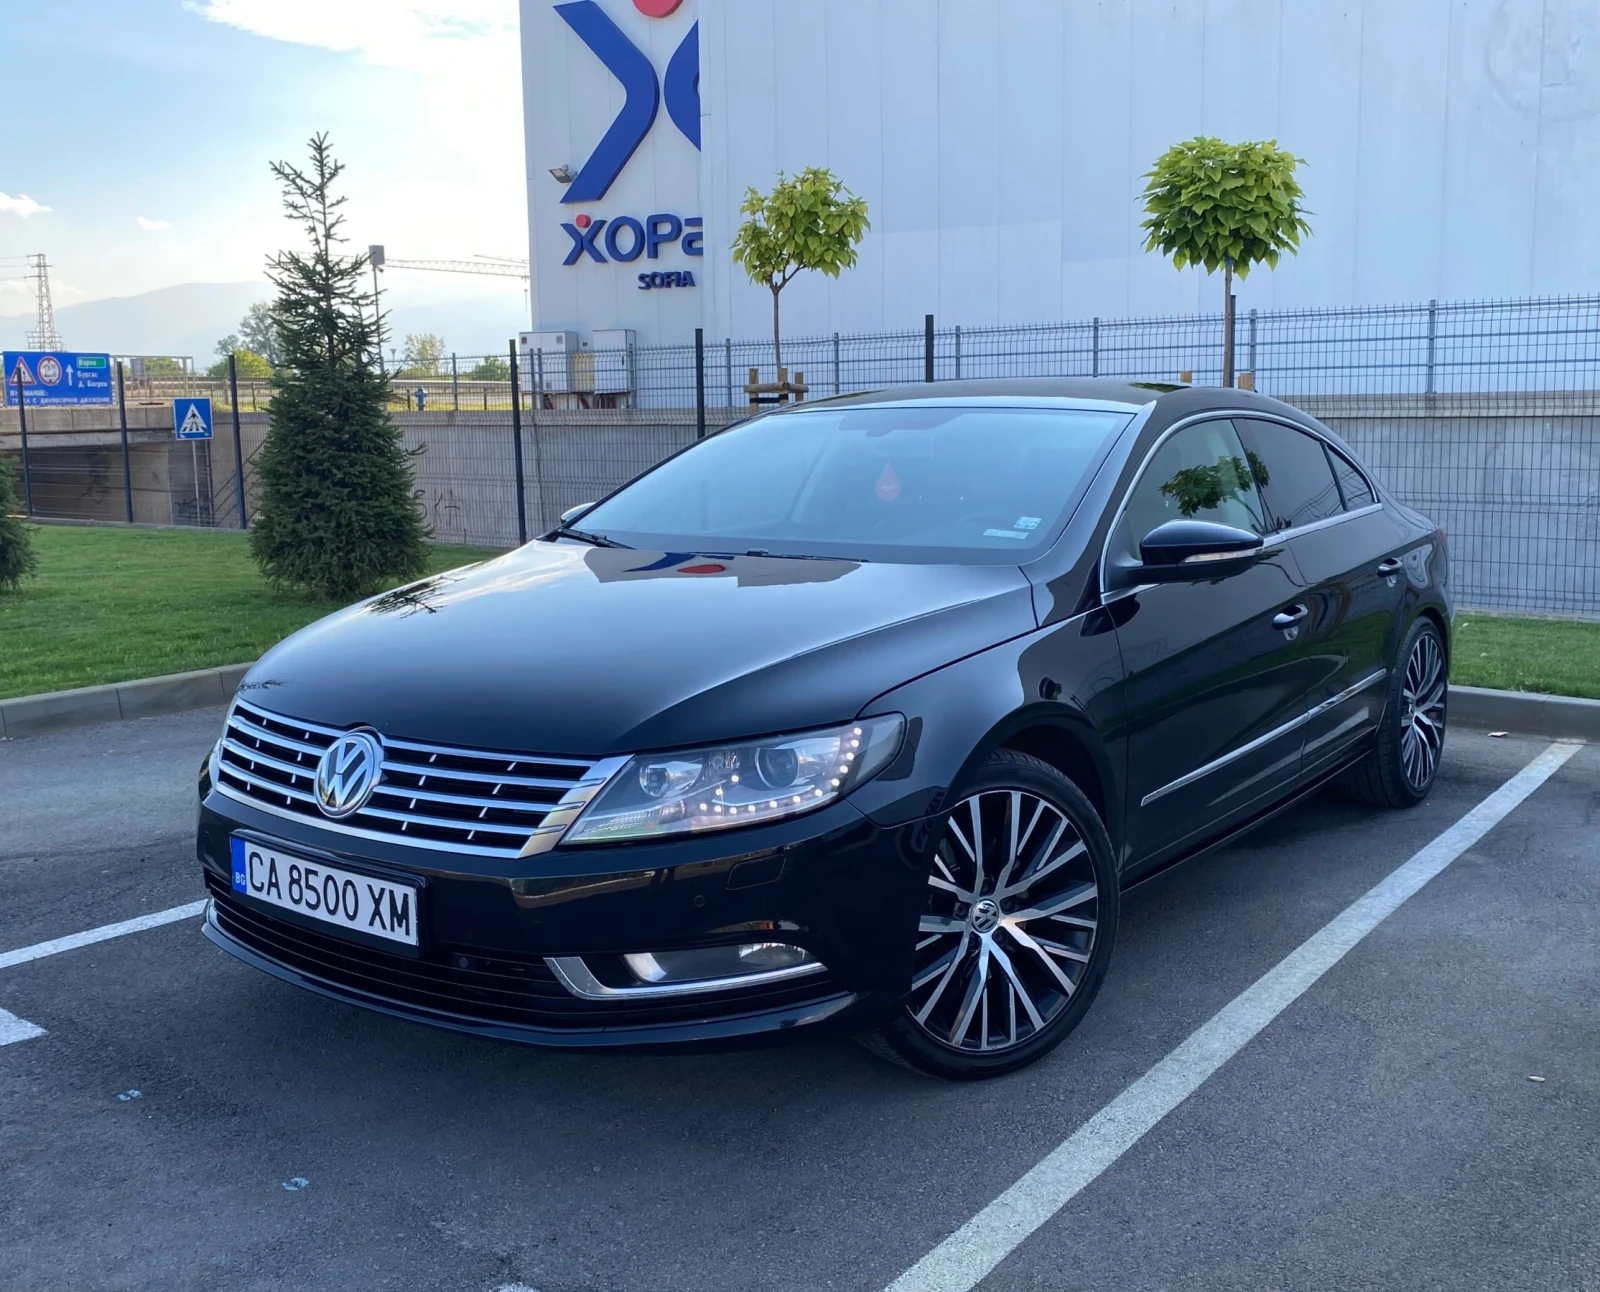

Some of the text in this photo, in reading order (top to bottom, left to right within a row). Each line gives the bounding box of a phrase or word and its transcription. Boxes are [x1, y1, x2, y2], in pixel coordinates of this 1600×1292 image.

[638, 271, 696, 290] SOFIA
[77, 371, 98, 379] Бургас
[235, 871, 246, 886] BG
[249, 851, 411, 936] CA 8500 XM
